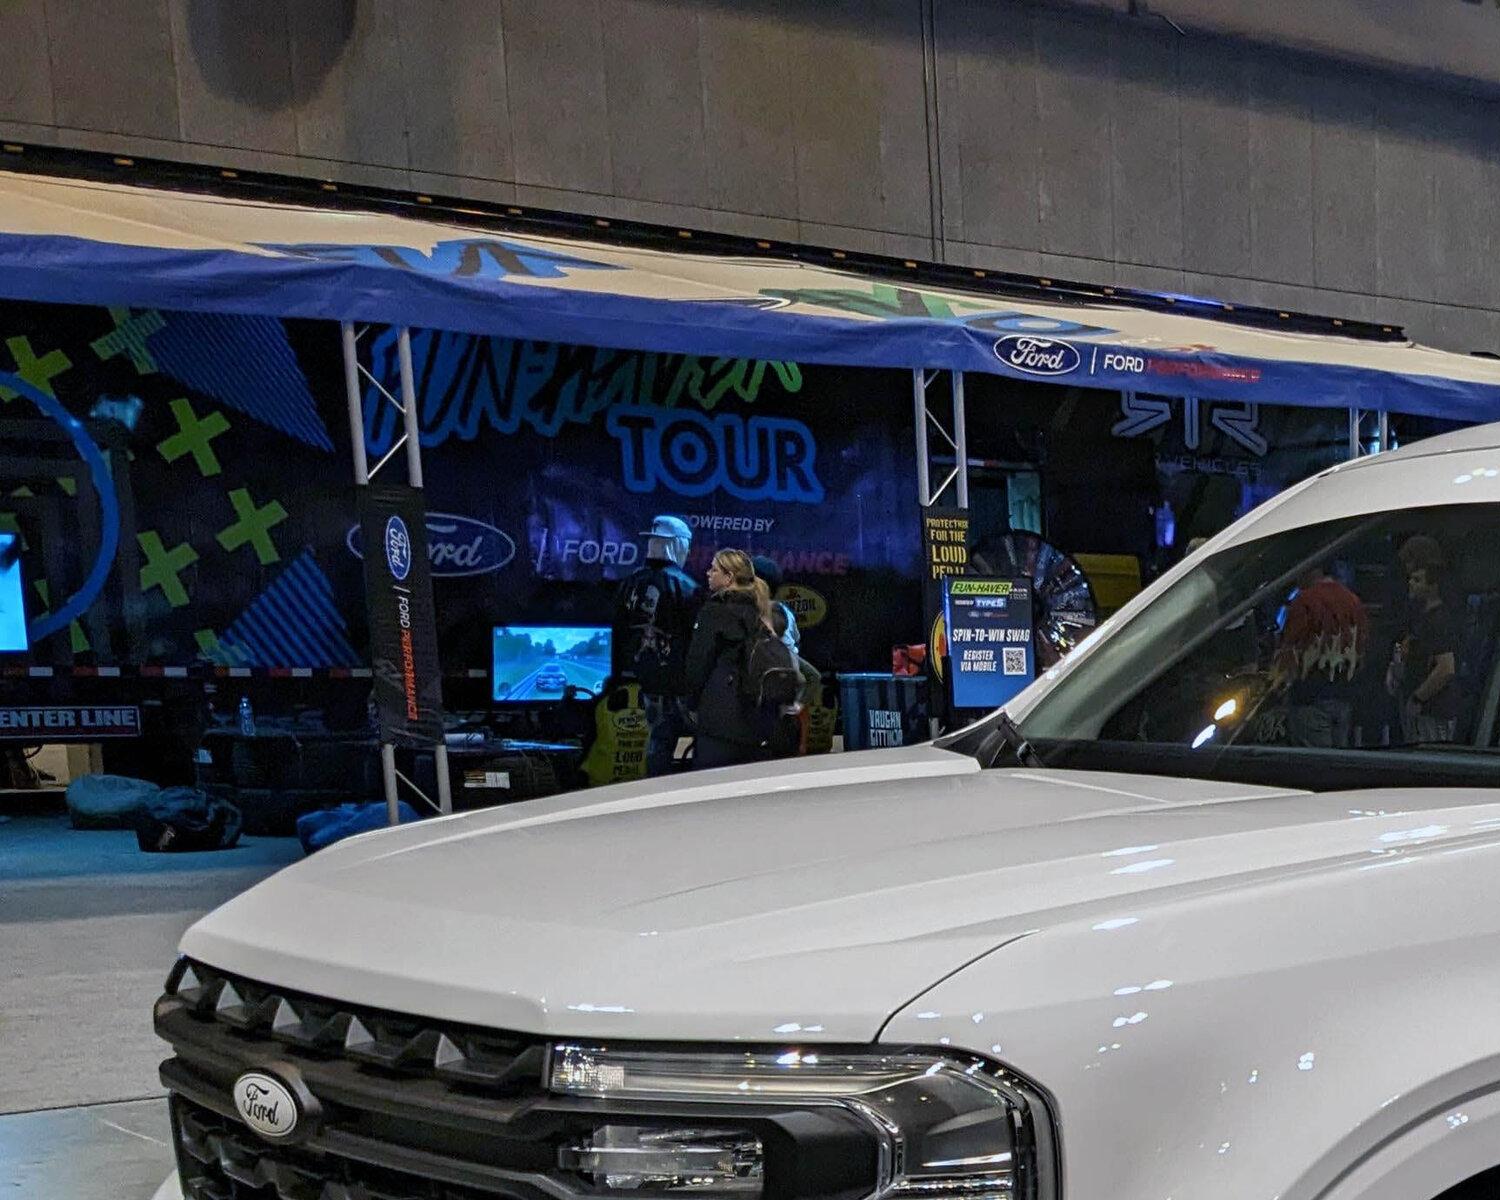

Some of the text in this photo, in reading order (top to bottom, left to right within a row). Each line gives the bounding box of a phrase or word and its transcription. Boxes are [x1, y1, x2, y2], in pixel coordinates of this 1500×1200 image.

[1010, 338, 1064, 370] Ford
[1103, 354, 1144, 373] FORD
[608, 404, 826, 503] TOUR
[754, 517, 775, 533] BY
[949, 530, 966, 543] THE
[562, 540, 638, 566] FORD
[931, 544, 967, 564] LOUD
[398, 595, 411, 629] FORD
[952, 627, 1031, 643] SPIN-TO-WIN SWAG
[963, 650, 994, 661] REGISTER
[960, 661, 998, 672] VIA MOBILE
[80, 709, 136, 727] LINE
